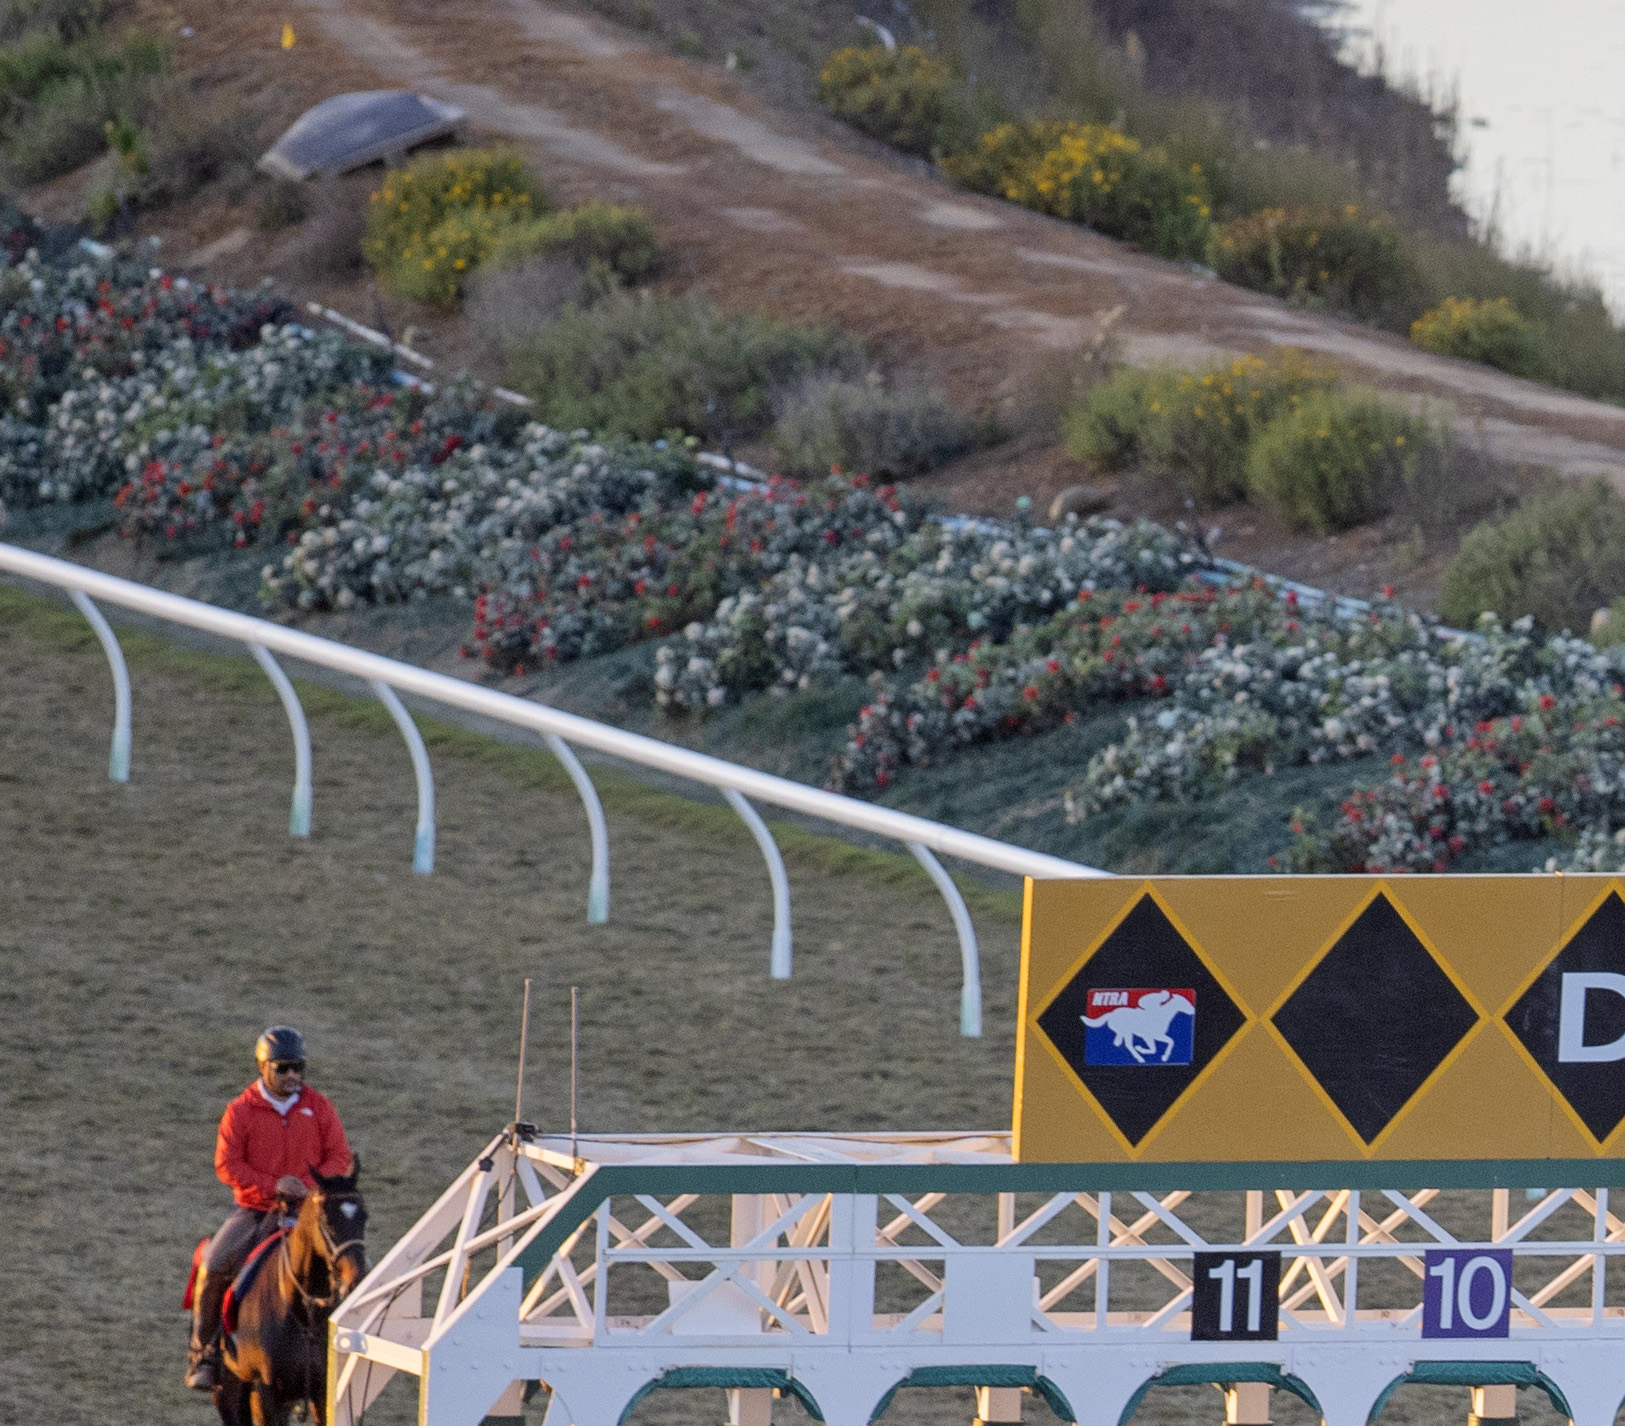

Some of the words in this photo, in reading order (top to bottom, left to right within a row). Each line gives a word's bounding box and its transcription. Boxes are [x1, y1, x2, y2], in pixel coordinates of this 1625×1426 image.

[1092, 991, 1129, 1006] NTRA
[1208, 1259, 1263, 1332] 11
[1429, 1256, 1508, 1331] 10
